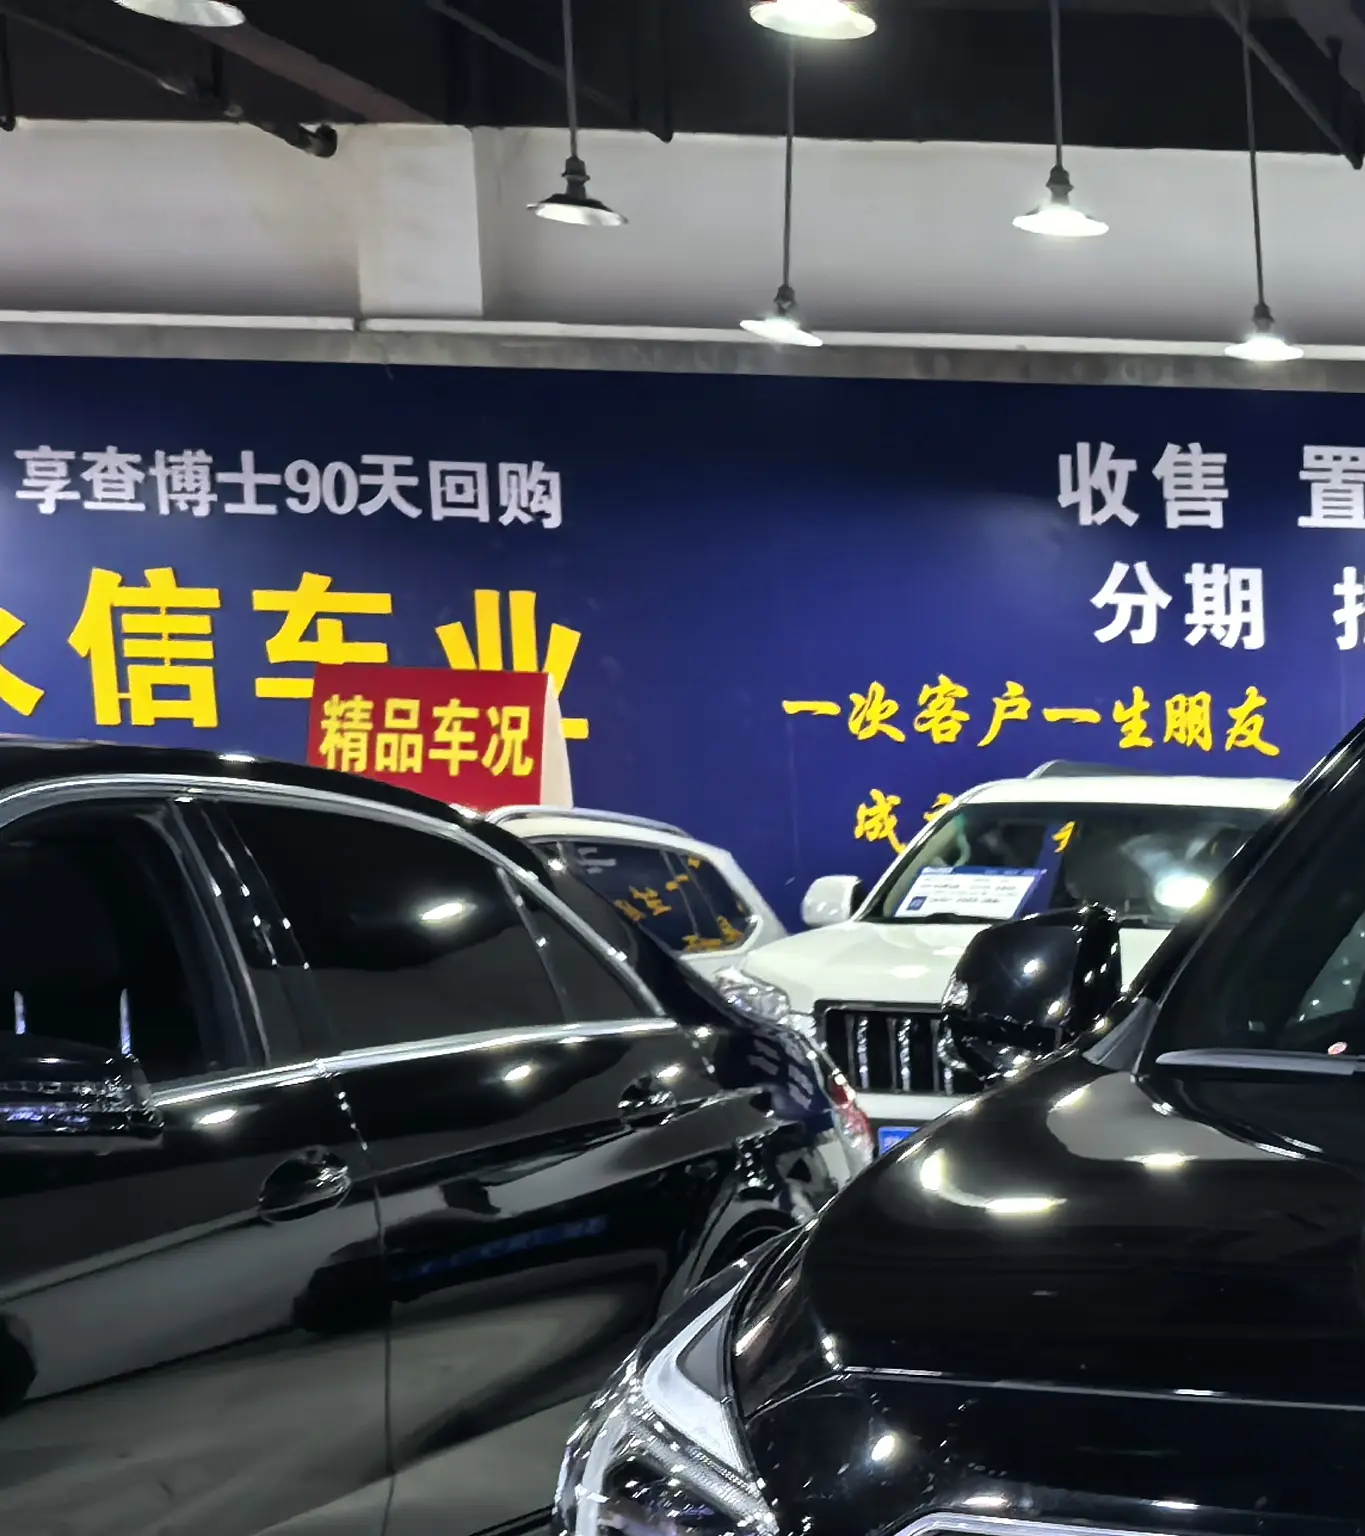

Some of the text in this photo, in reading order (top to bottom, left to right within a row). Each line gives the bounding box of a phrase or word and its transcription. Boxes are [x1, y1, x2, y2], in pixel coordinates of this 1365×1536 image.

[13, 445, 563, 529] 享查博士90天回购
[1057, 442, 1230, 529] 收售
[1090, 561, 1266, 649] 分期
[319, 694, 534, 777] 精品车况
[782, 673, 1280, 756] 一次客户一生朋友
